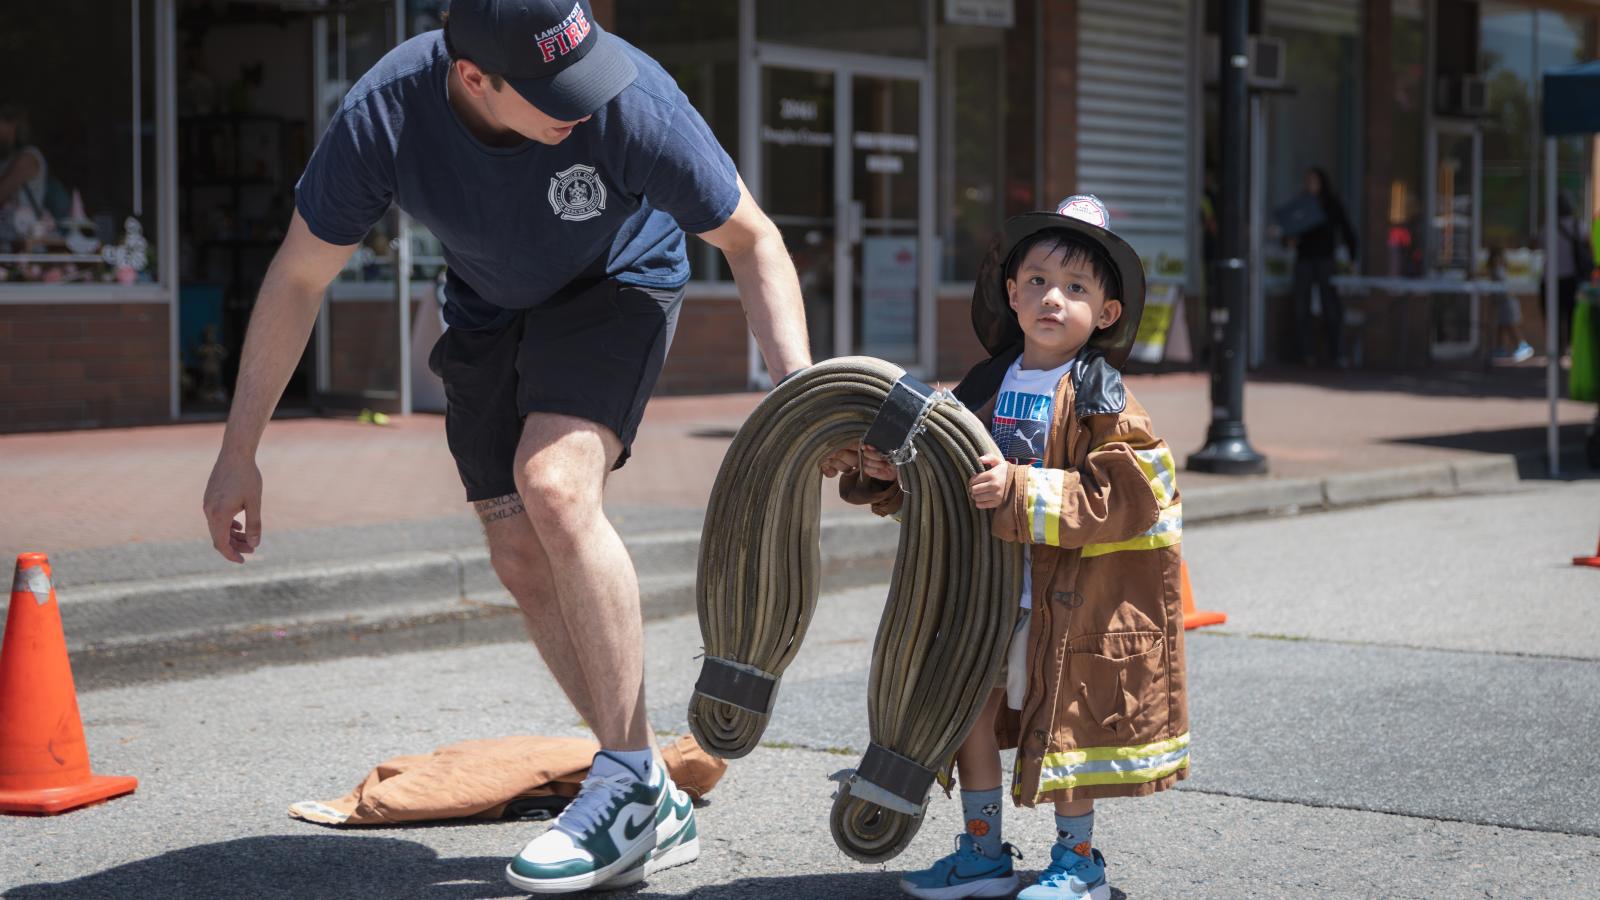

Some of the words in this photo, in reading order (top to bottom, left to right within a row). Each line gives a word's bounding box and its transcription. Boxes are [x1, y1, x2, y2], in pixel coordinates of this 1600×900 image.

[534, 15, 573, 41] LANGLEY
[537, 9, 591, 63] FIRE
[997, 391, 1052, 421] UMA
